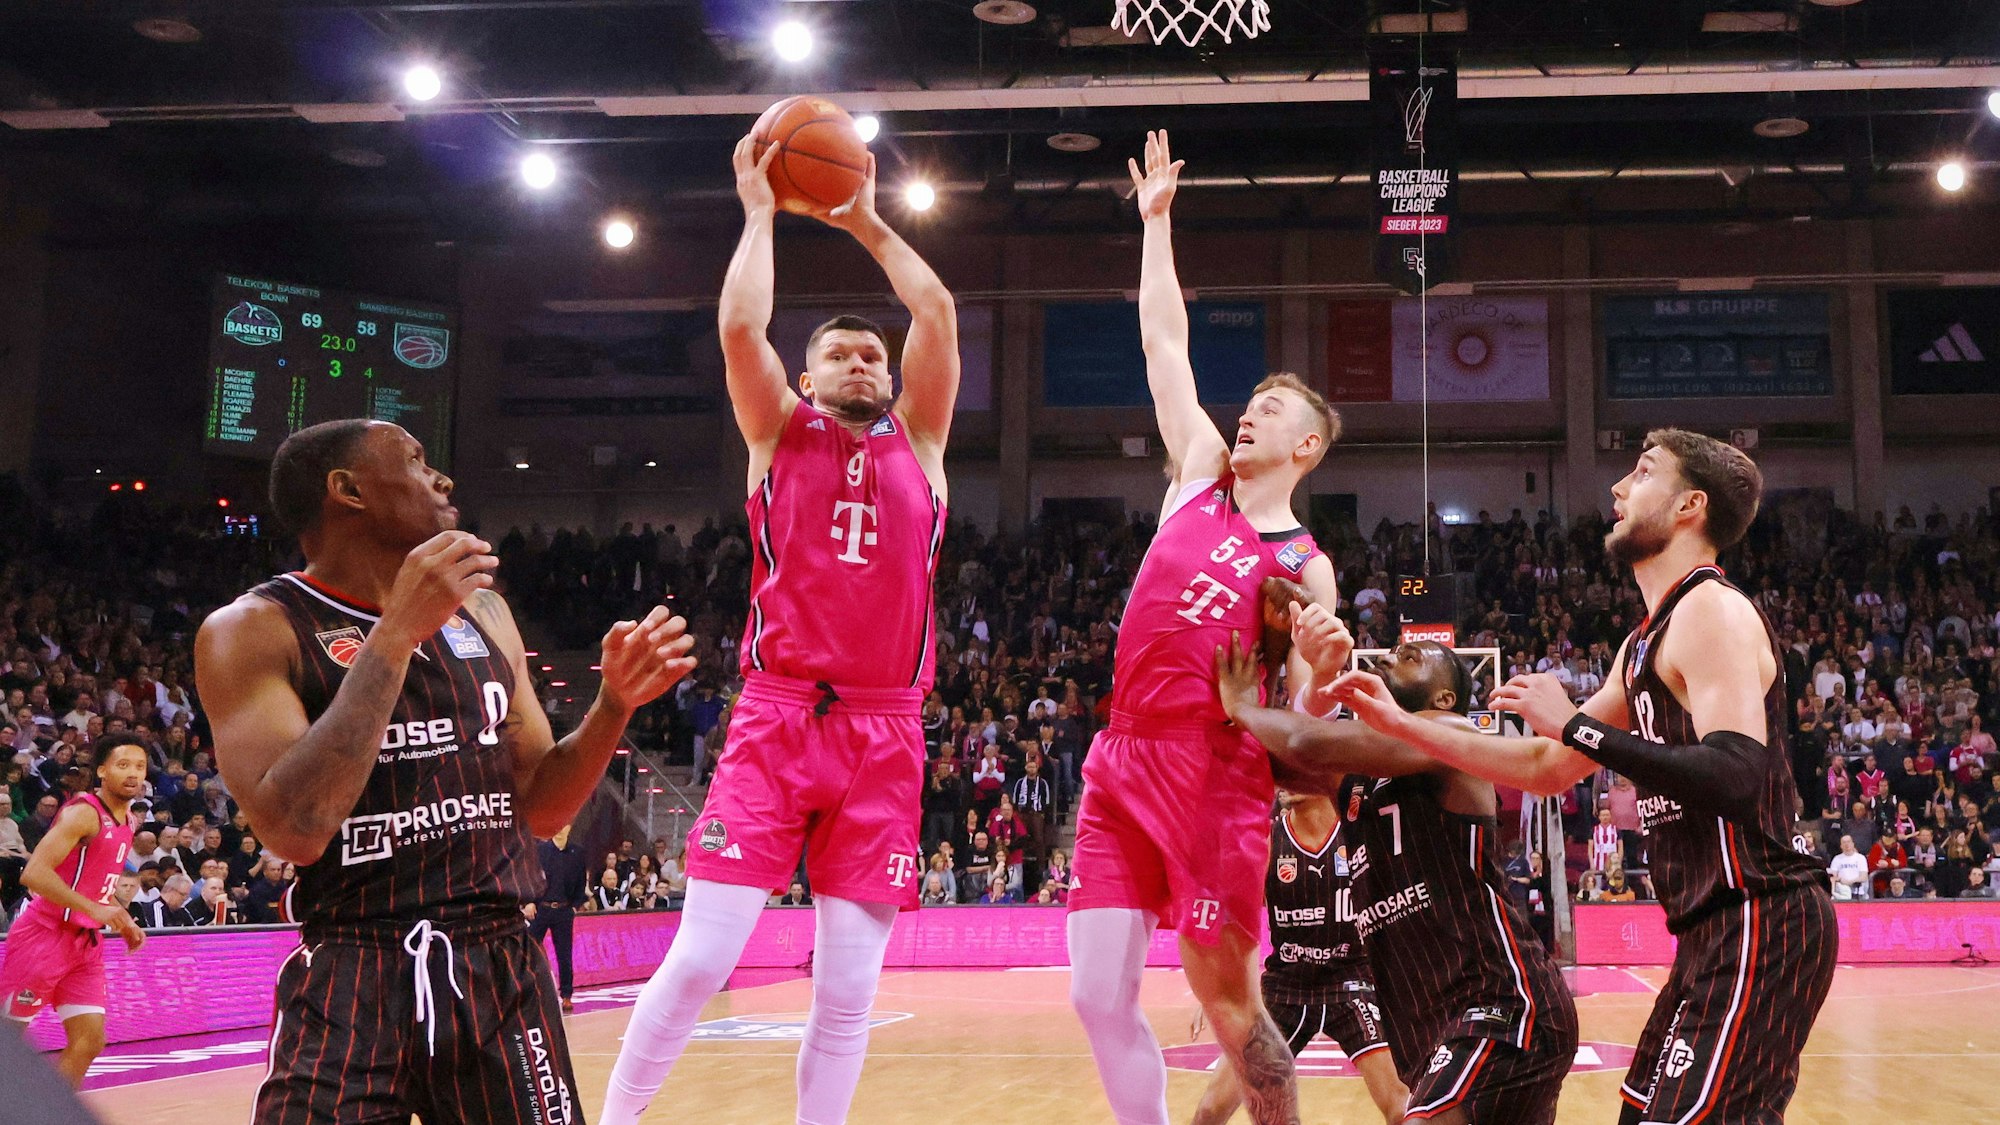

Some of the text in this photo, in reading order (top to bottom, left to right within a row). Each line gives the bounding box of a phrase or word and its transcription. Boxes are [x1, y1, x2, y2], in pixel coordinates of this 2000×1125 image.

[1378, 169, 1450, 184] BASKETBALL
[1380, 184, 1448, 199] CHAMPIONS
[1392, 198, 1437, 213] LEAGUE
[1386, 219, 1442, 231] SIEGER 2023
[226, 275, 320, 298] TELEKOM BASKETS
[260, 292, 288, 303] BONN
[1697, 299, 1779, 314] GRUPPE
[226, 320, 279, 339] BASKETS
[301, 313, 322, 328] 69
[357, 321, 376, 336] 58
[320, 334, 356, 352] 23.0
[329, 360, 342, 378] 3
[364, 368, 373, 379] 4
[219, 433, 255, 442] KENNEDY
[1610, 432, 1623, 448] H
[846, 451, 865, 487] 9
[830, 500, 878, 565] T
[1209, 535, 1260, 579] 54
[1278, 553, 1301, 571] BBL
[1176, 571, 1241, 625] T
[455, 639, 483, 654] BBL
[477, 681, 509, 745] 0
[1634, 691, 1665, 745] 12
[381, 717, 456, 750] ose
[377, 743, 459, 764] für Automobile
[393, 792, 512, 837] PRIOSAFE
[396, 829, 445, 848] safety
[450, 820, 487, 835] starts
[1378, 803, 1403, 857] 7
[115, 842, 127, 865] 0
[886, 852, 913, 888] T
[1192, 898, 1220, 930] T
[1273, 905, 1326, 922] brose
[1335, 888, 1353, 923] 10
[1491, 1007, 1503, 1017] XL
[514, 1033, 522, 1041] A
[517, 1043, 531, 1080] member
[527, 1027, 563, 1125] DATOLU
